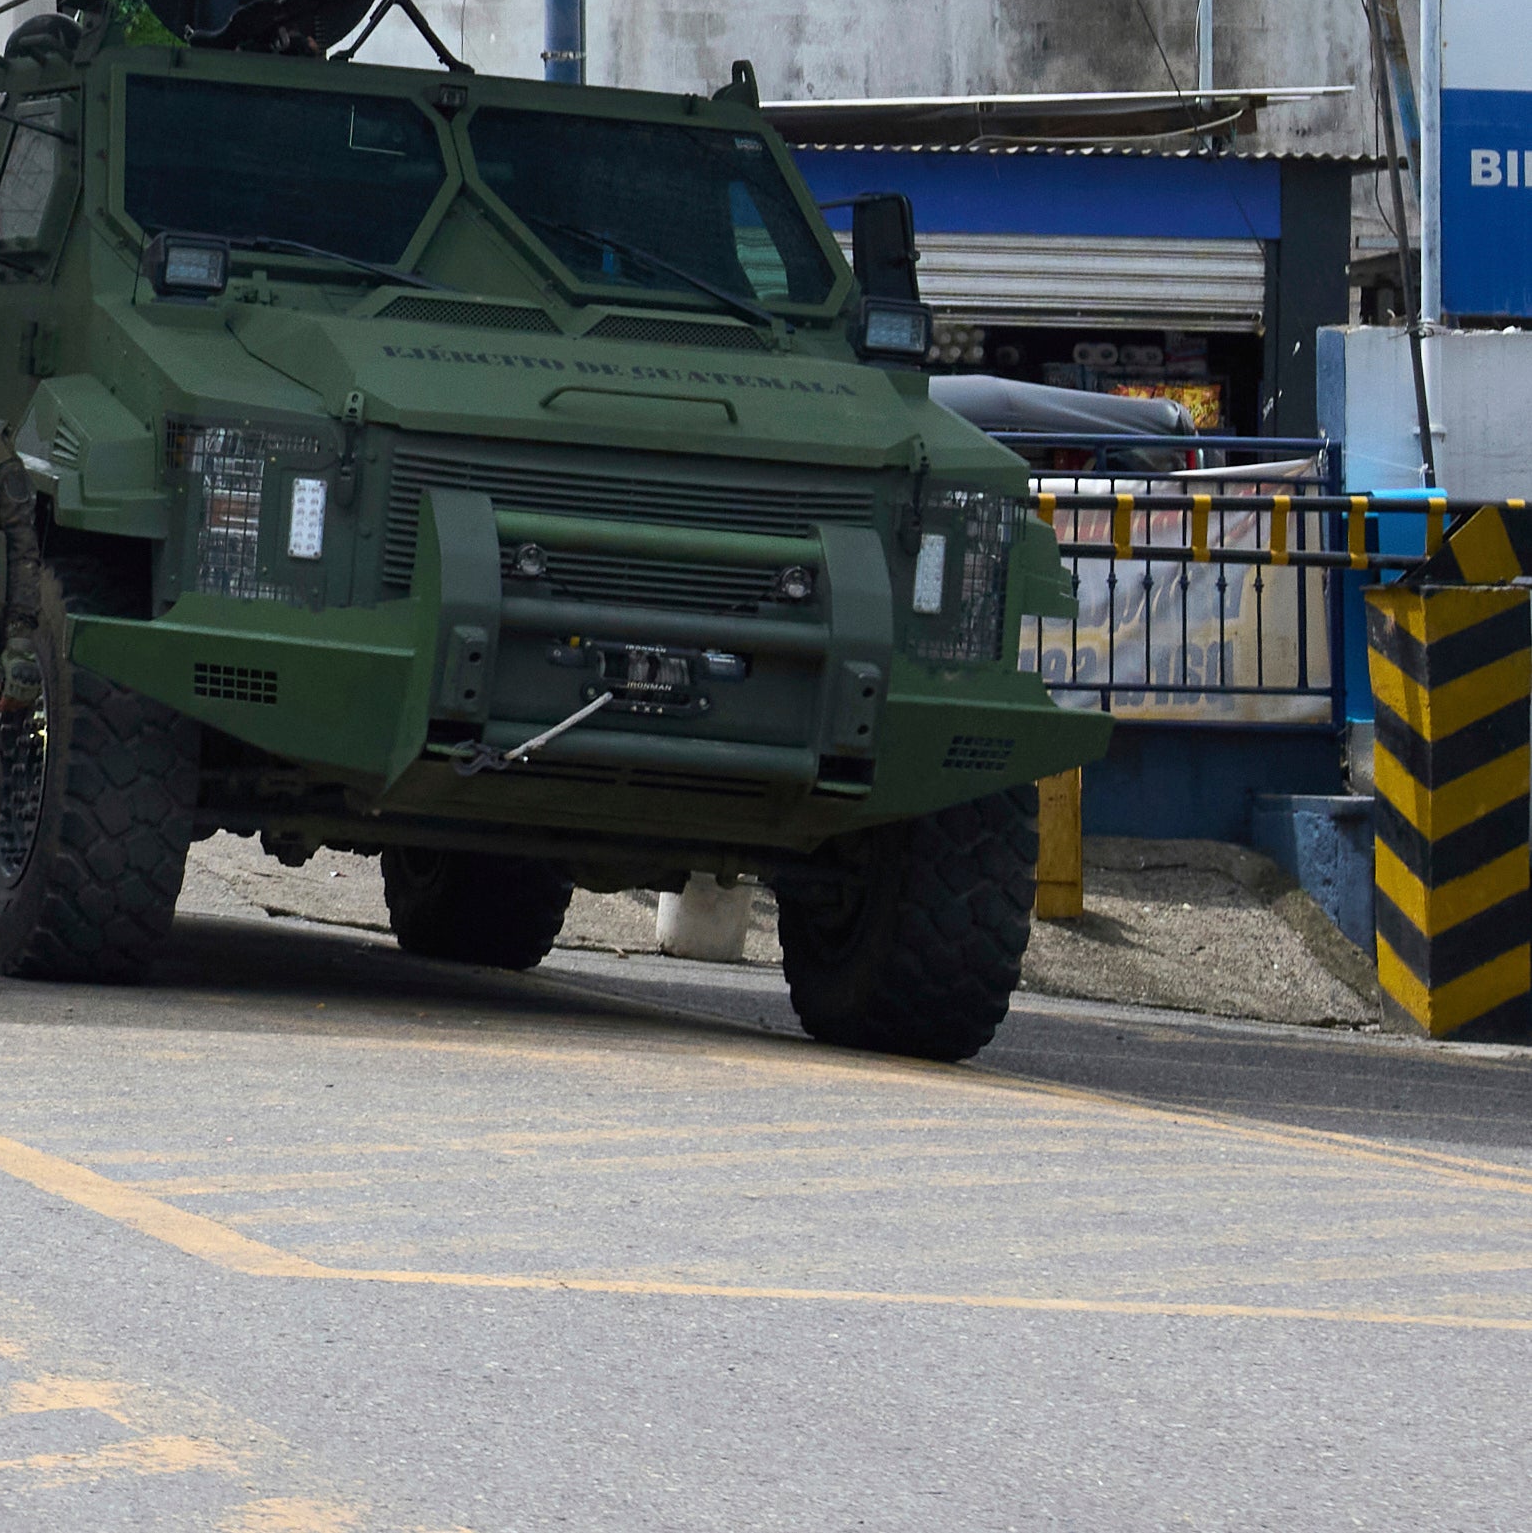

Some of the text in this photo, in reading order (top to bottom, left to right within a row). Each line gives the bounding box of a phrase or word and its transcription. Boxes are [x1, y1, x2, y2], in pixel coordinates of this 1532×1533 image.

[1470, 148, 1532, 188] BI
[574, 358, 621, 378] DE
[630, 365, 859, 397] GUATEMALA
[625, 644, 667, 654] IRONMAN
[627, 681, 673, 692] IRONMAN
